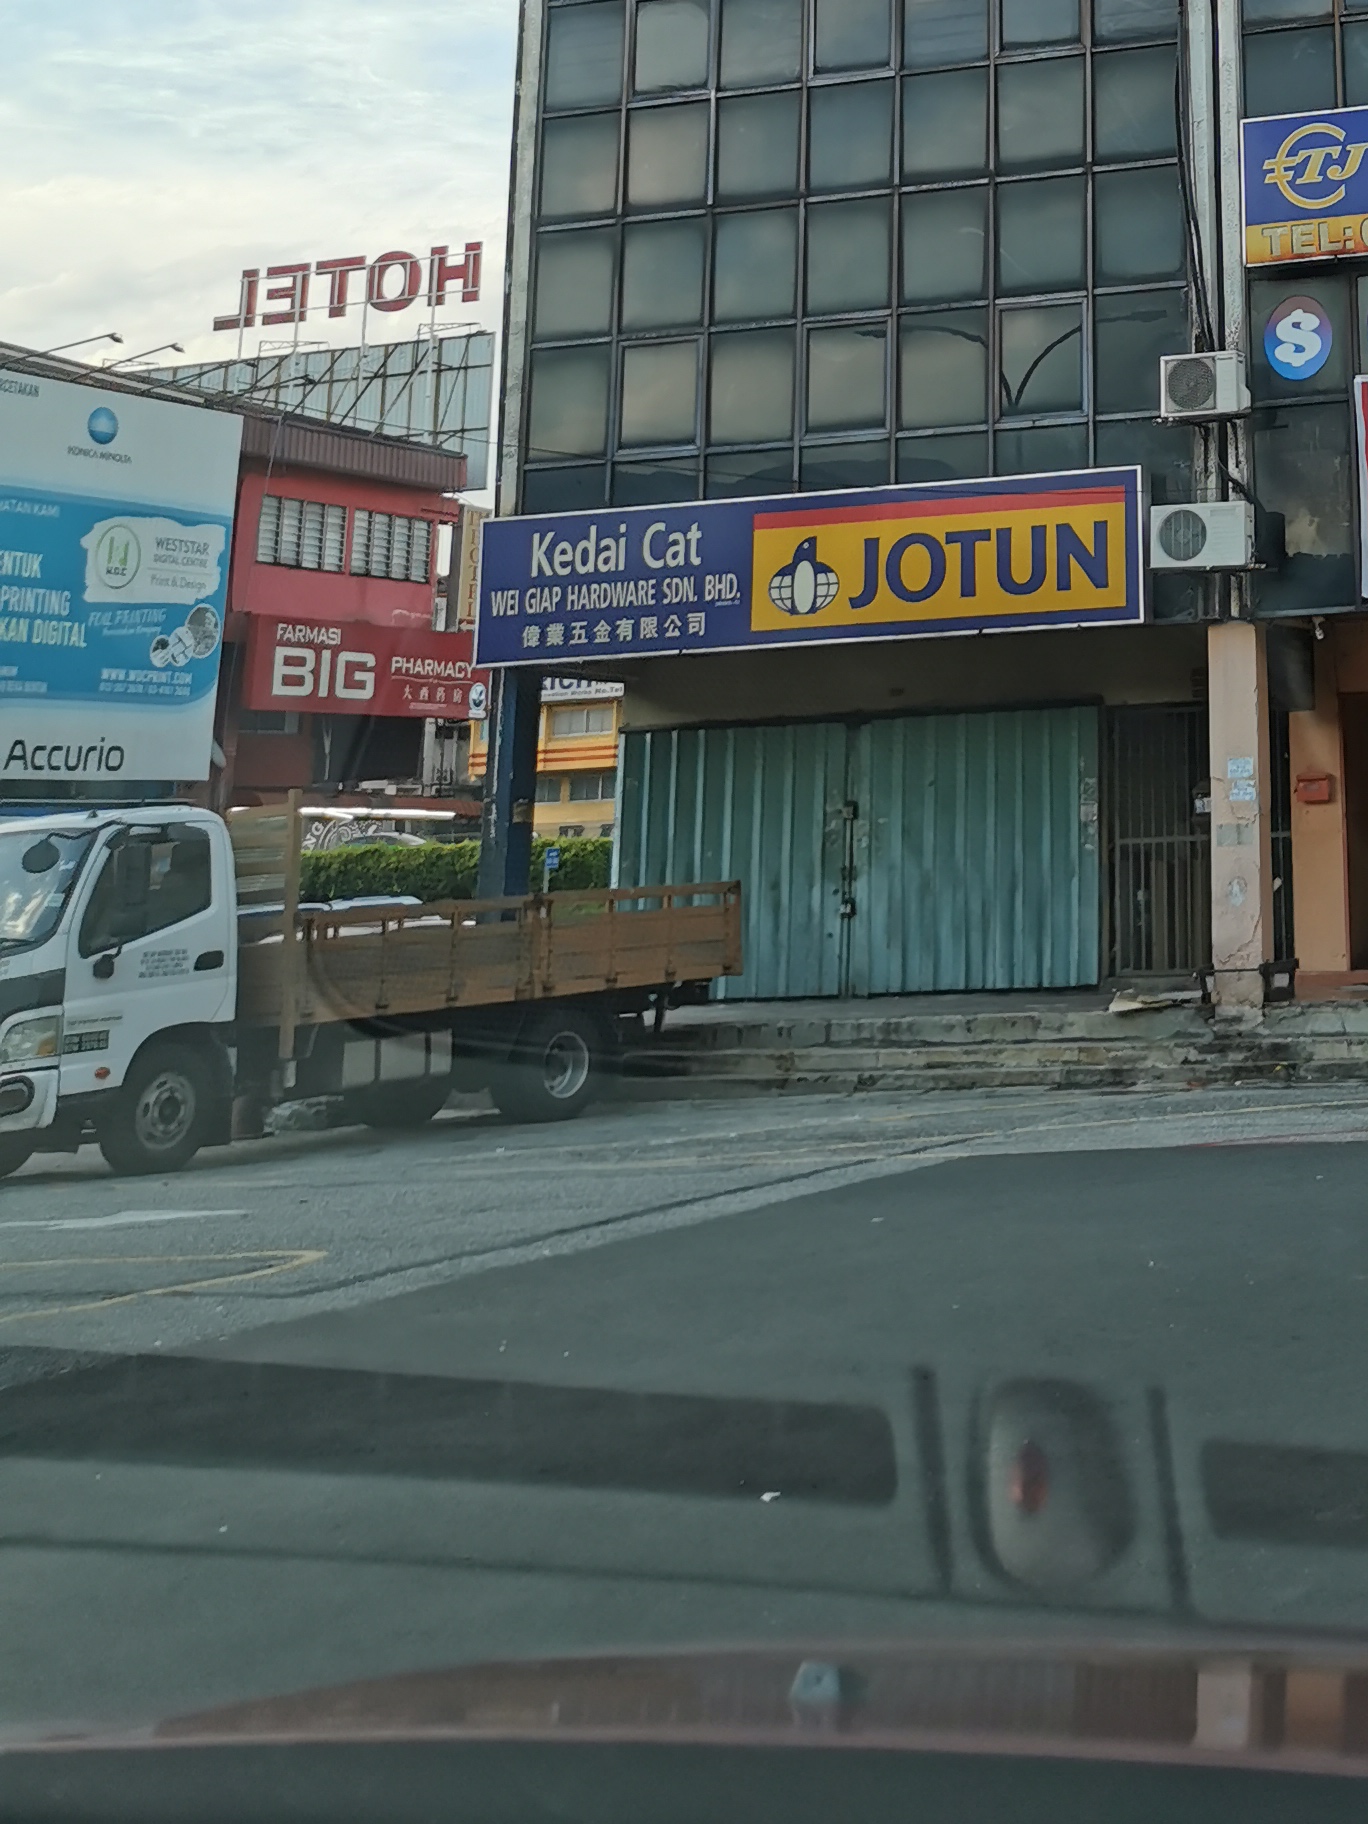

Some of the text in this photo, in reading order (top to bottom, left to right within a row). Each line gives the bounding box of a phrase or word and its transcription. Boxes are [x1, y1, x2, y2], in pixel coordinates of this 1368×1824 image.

[1262, 221, 1355, 257] TEL:
[67, 445, 132, 464] KONICA MINOLTA
[155, 537, 210, 557] WESTSTAR
[531, 523, 627, 578] Kedai
[642, 521, 702, 569] Cat
[849, 519, 1109, 609] JOTUN
[1, 585, 71, 616] PRINTING
[491, 573, 741, 617] WEI GIAP HARDWARE SDN. BHD.
[32, 619, 87, 648] DIGITAL
[277, 623, 341, 645] FARMASI
[522, 612, 706, 648] 偉業五金有限公司
[271, 646, 376, 700] BIG
[391, 656, 473, 679] PHARMACY
[3, 737, 125, 772] Accurio
